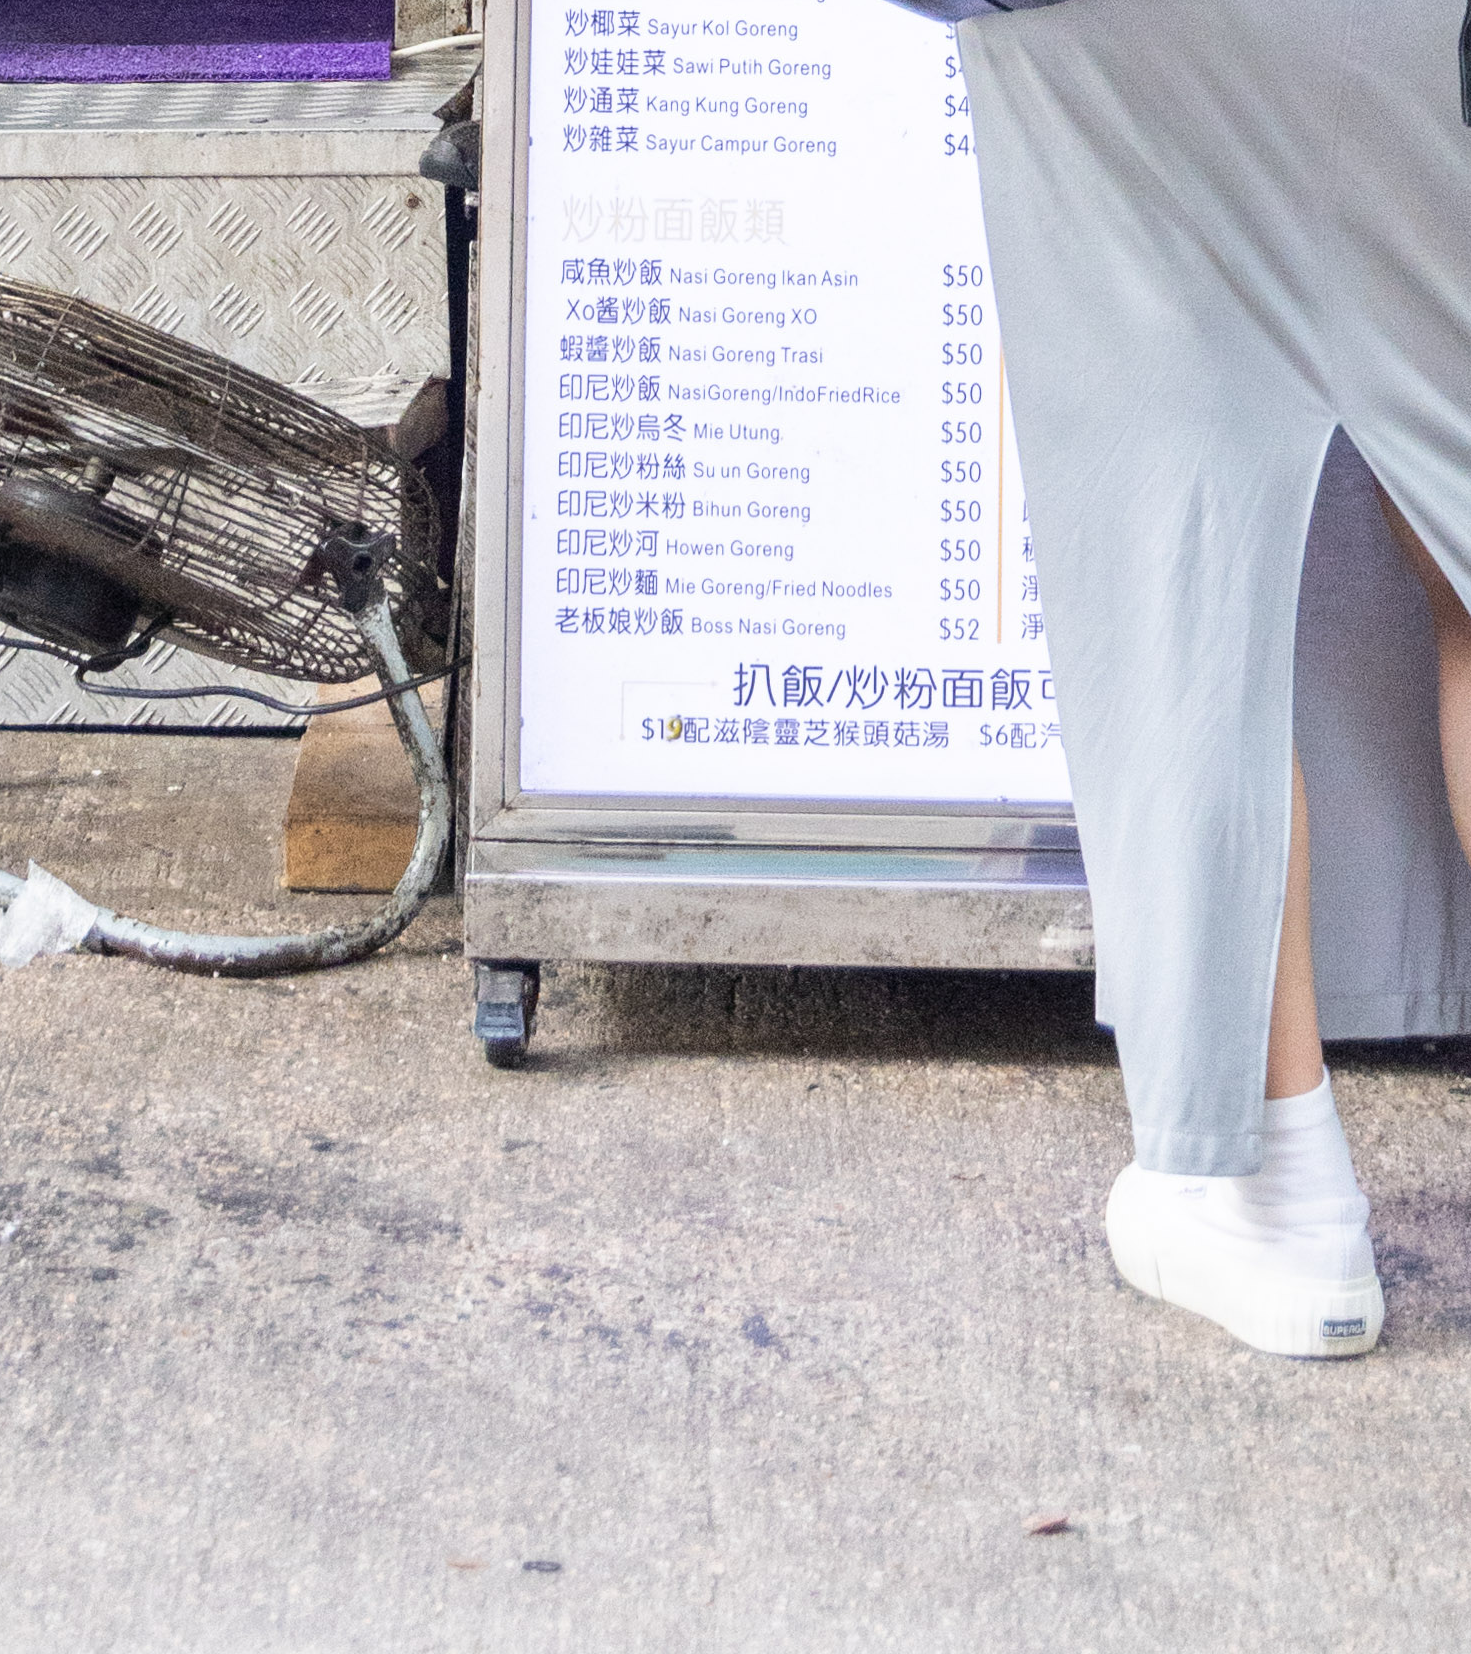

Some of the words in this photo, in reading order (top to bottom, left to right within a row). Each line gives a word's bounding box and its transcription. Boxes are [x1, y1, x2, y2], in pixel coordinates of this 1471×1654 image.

[560, 257, 663, 287] 咸魚炒飯
[670, 268, 708, 286] Nasi
[713, 269, 777, 290] Goreng
[782, 270, 817, 287] Ikan
[821, 270, 858, 288] Asin
[942, 265, 984, 289] $50
[559, 373, 661, 403] 印尼炒飯
[941, 382, 983, 405] $50
[555, 606, 684, 636] 老板娘炒飯
[691, 617, 733, 636] Boss
[739, 618, 778, 636] Nasi
[782, 619, 846, 640] Goreng
[939, 619, 980, 641] $52
